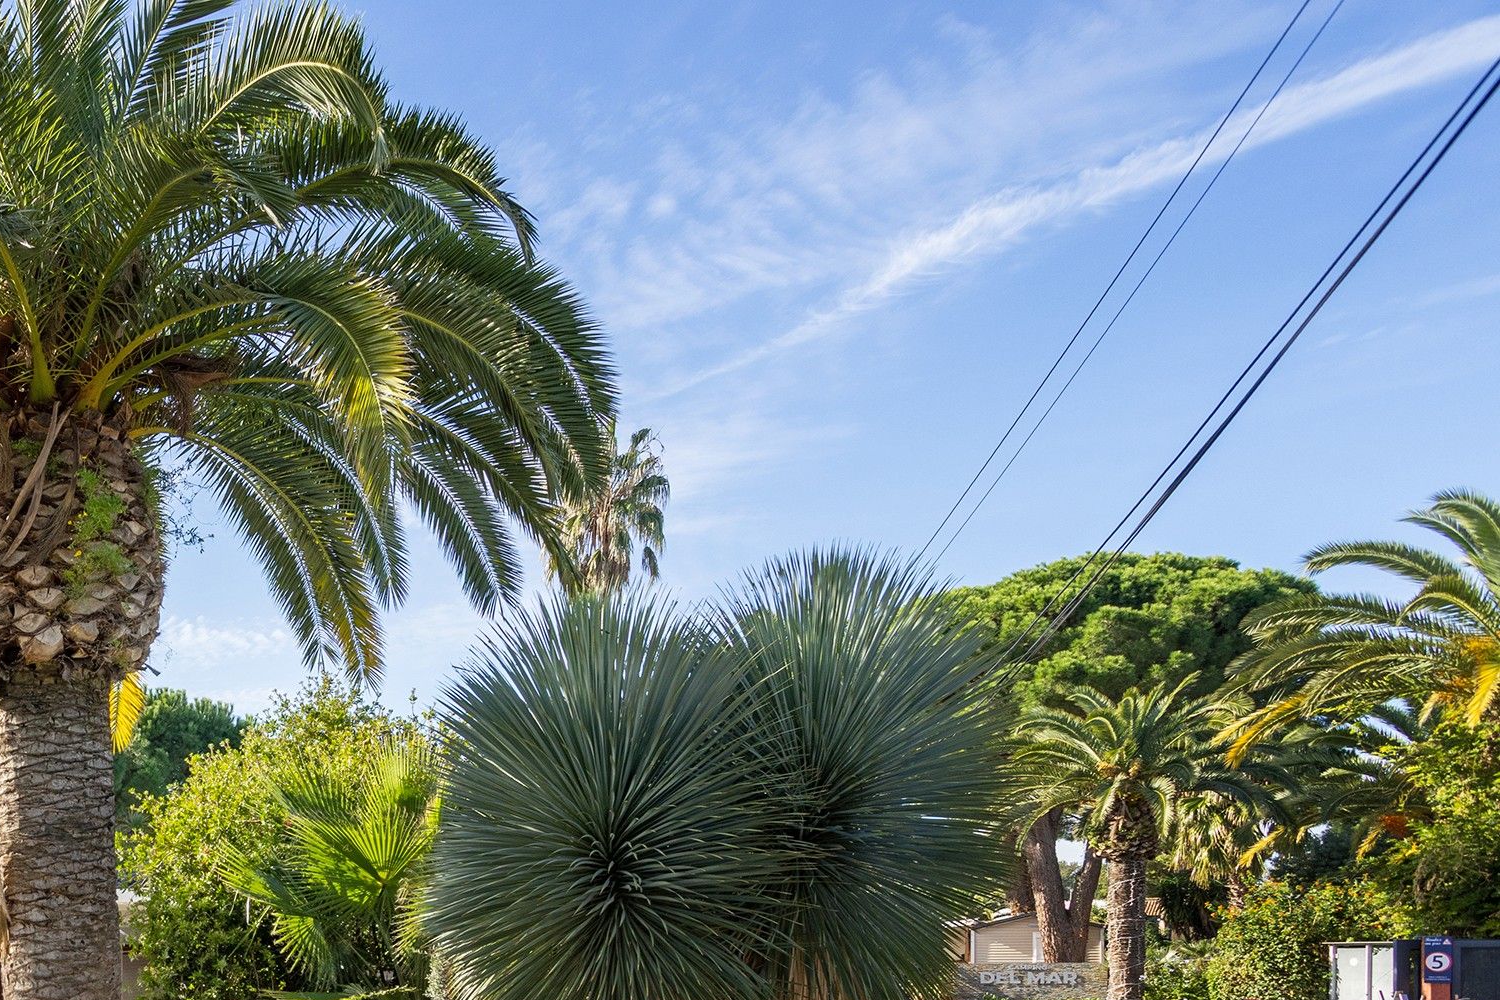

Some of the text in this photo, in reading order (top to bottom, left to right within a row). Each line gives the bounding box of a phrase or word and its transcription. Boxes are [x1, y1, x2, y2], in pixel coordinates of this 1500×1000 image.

[1431, 955, 1443, 969] 5
[979, 971, 1078, 985] DEL MAR
